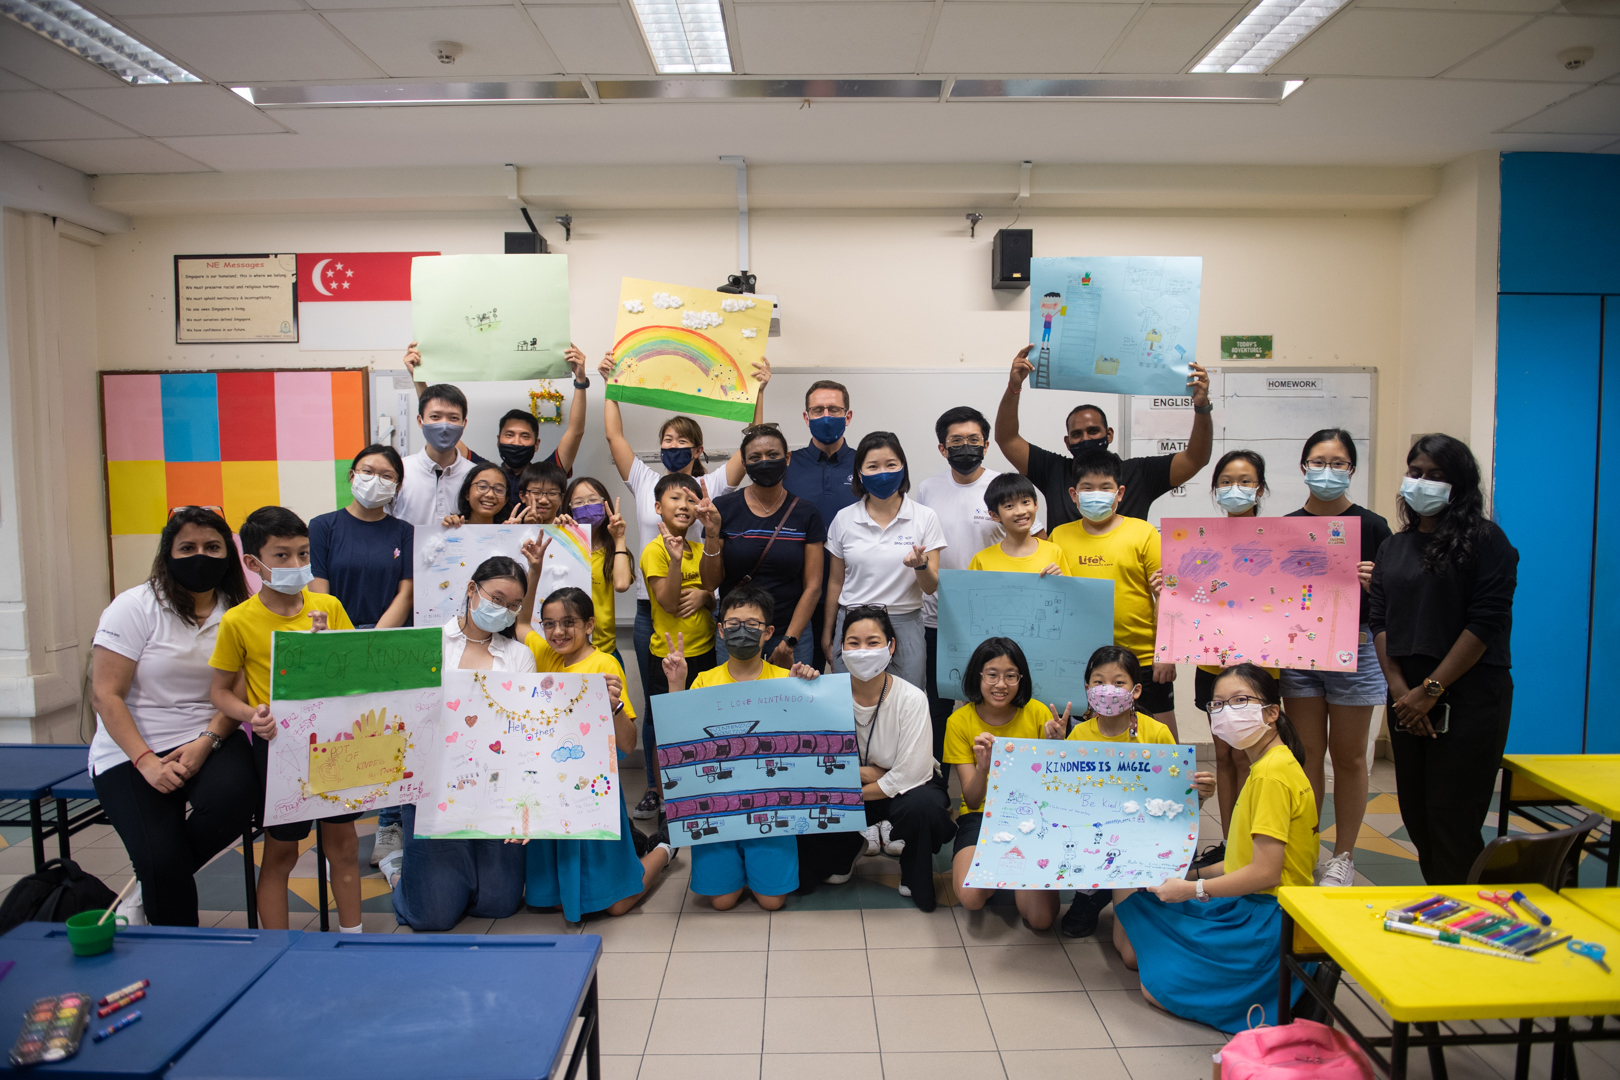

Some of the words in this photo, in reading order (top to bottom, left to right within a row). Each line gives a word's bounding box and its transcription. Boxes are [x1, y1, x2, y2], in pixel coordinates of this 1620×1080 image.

[276, 636, 305, 669] POT
[324, 650, 352, 679] OF
[367, 634, 442, 674] KINDNESS
[716, 700, 723, 710] I
[730, 698, 752, 708] LOVE
[758, 694, 803, 704] NINTENDO
[508, 720, 526, 734] Help
[330, 744, 350, 758] POT
[345, 751, 359, 762] OF
[1046, 761, 1096, 773] KINDNESS
[1099, 761, 1111, 772] IS
[1117, 761, 1150, 772] MAGIC
[1082, 794, 1096, 807] Be
